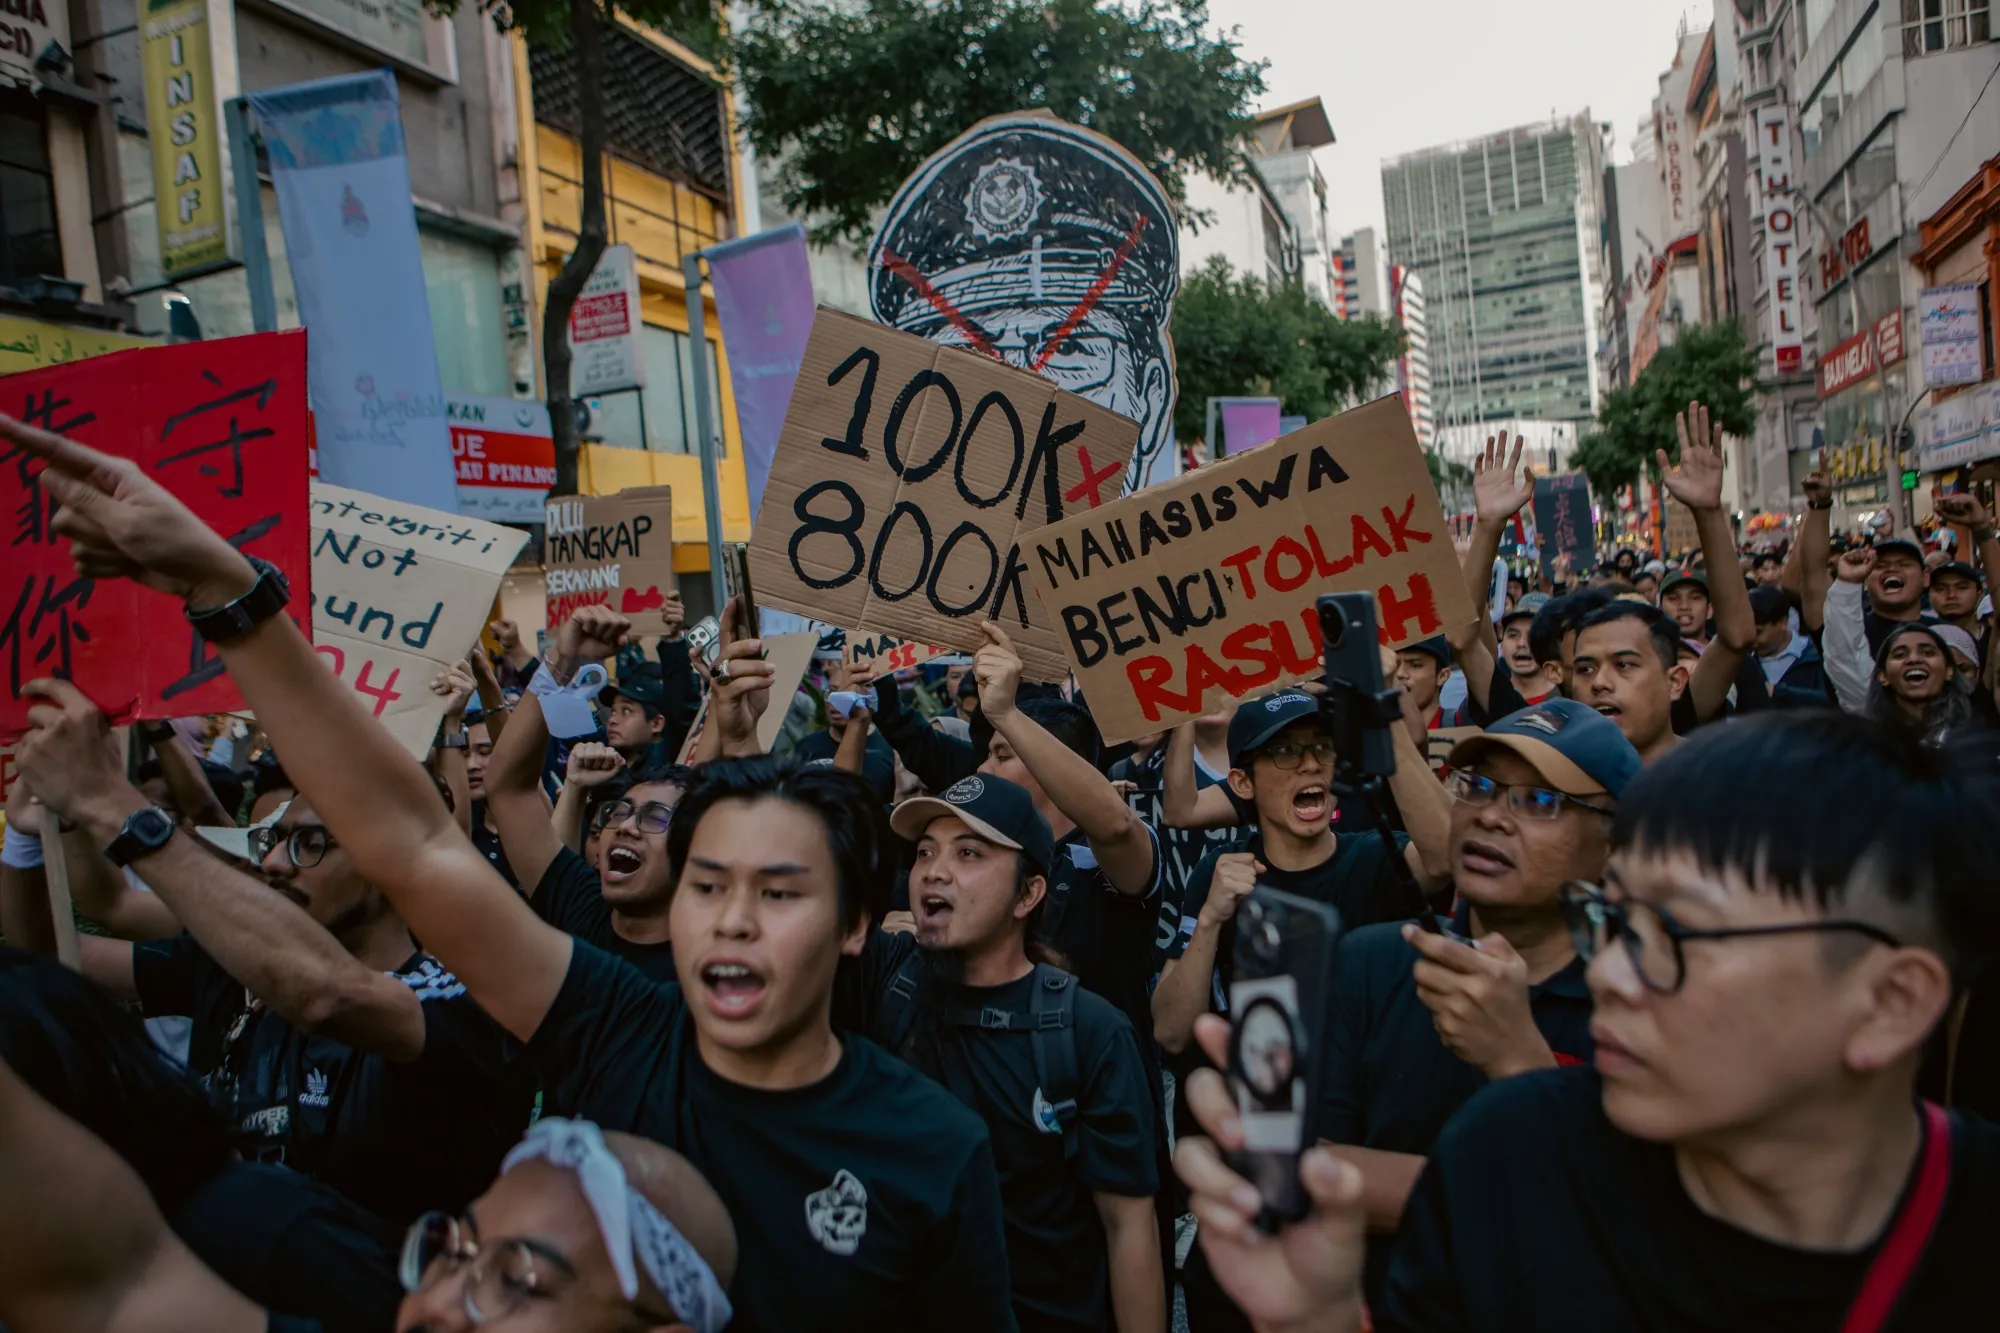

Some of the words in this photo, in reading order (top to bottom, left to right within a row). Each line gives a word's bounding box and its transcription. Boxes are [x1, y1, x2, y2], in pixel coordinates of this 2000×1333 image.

[168, 36, 201, 224] INSAF
[447, 402, 485, 423] KAN
[488, 461, 557, 485] PINANG
[312, 499, 498, 554] ntergriti
[548, 515, 652, 564] TANGKAP
[1036, 445, 1349, 589] MAHASISWA
[313, 528, 419, 577] Not
[789, 480, 1029, 629] 800K
[1221, 493, 1433, 600] TOLAK
[546, 564, 620, 595] SEKARANG
[1126, 572, 1443, 722] RASUH
[299, 1092, 330, 1107] adidas
